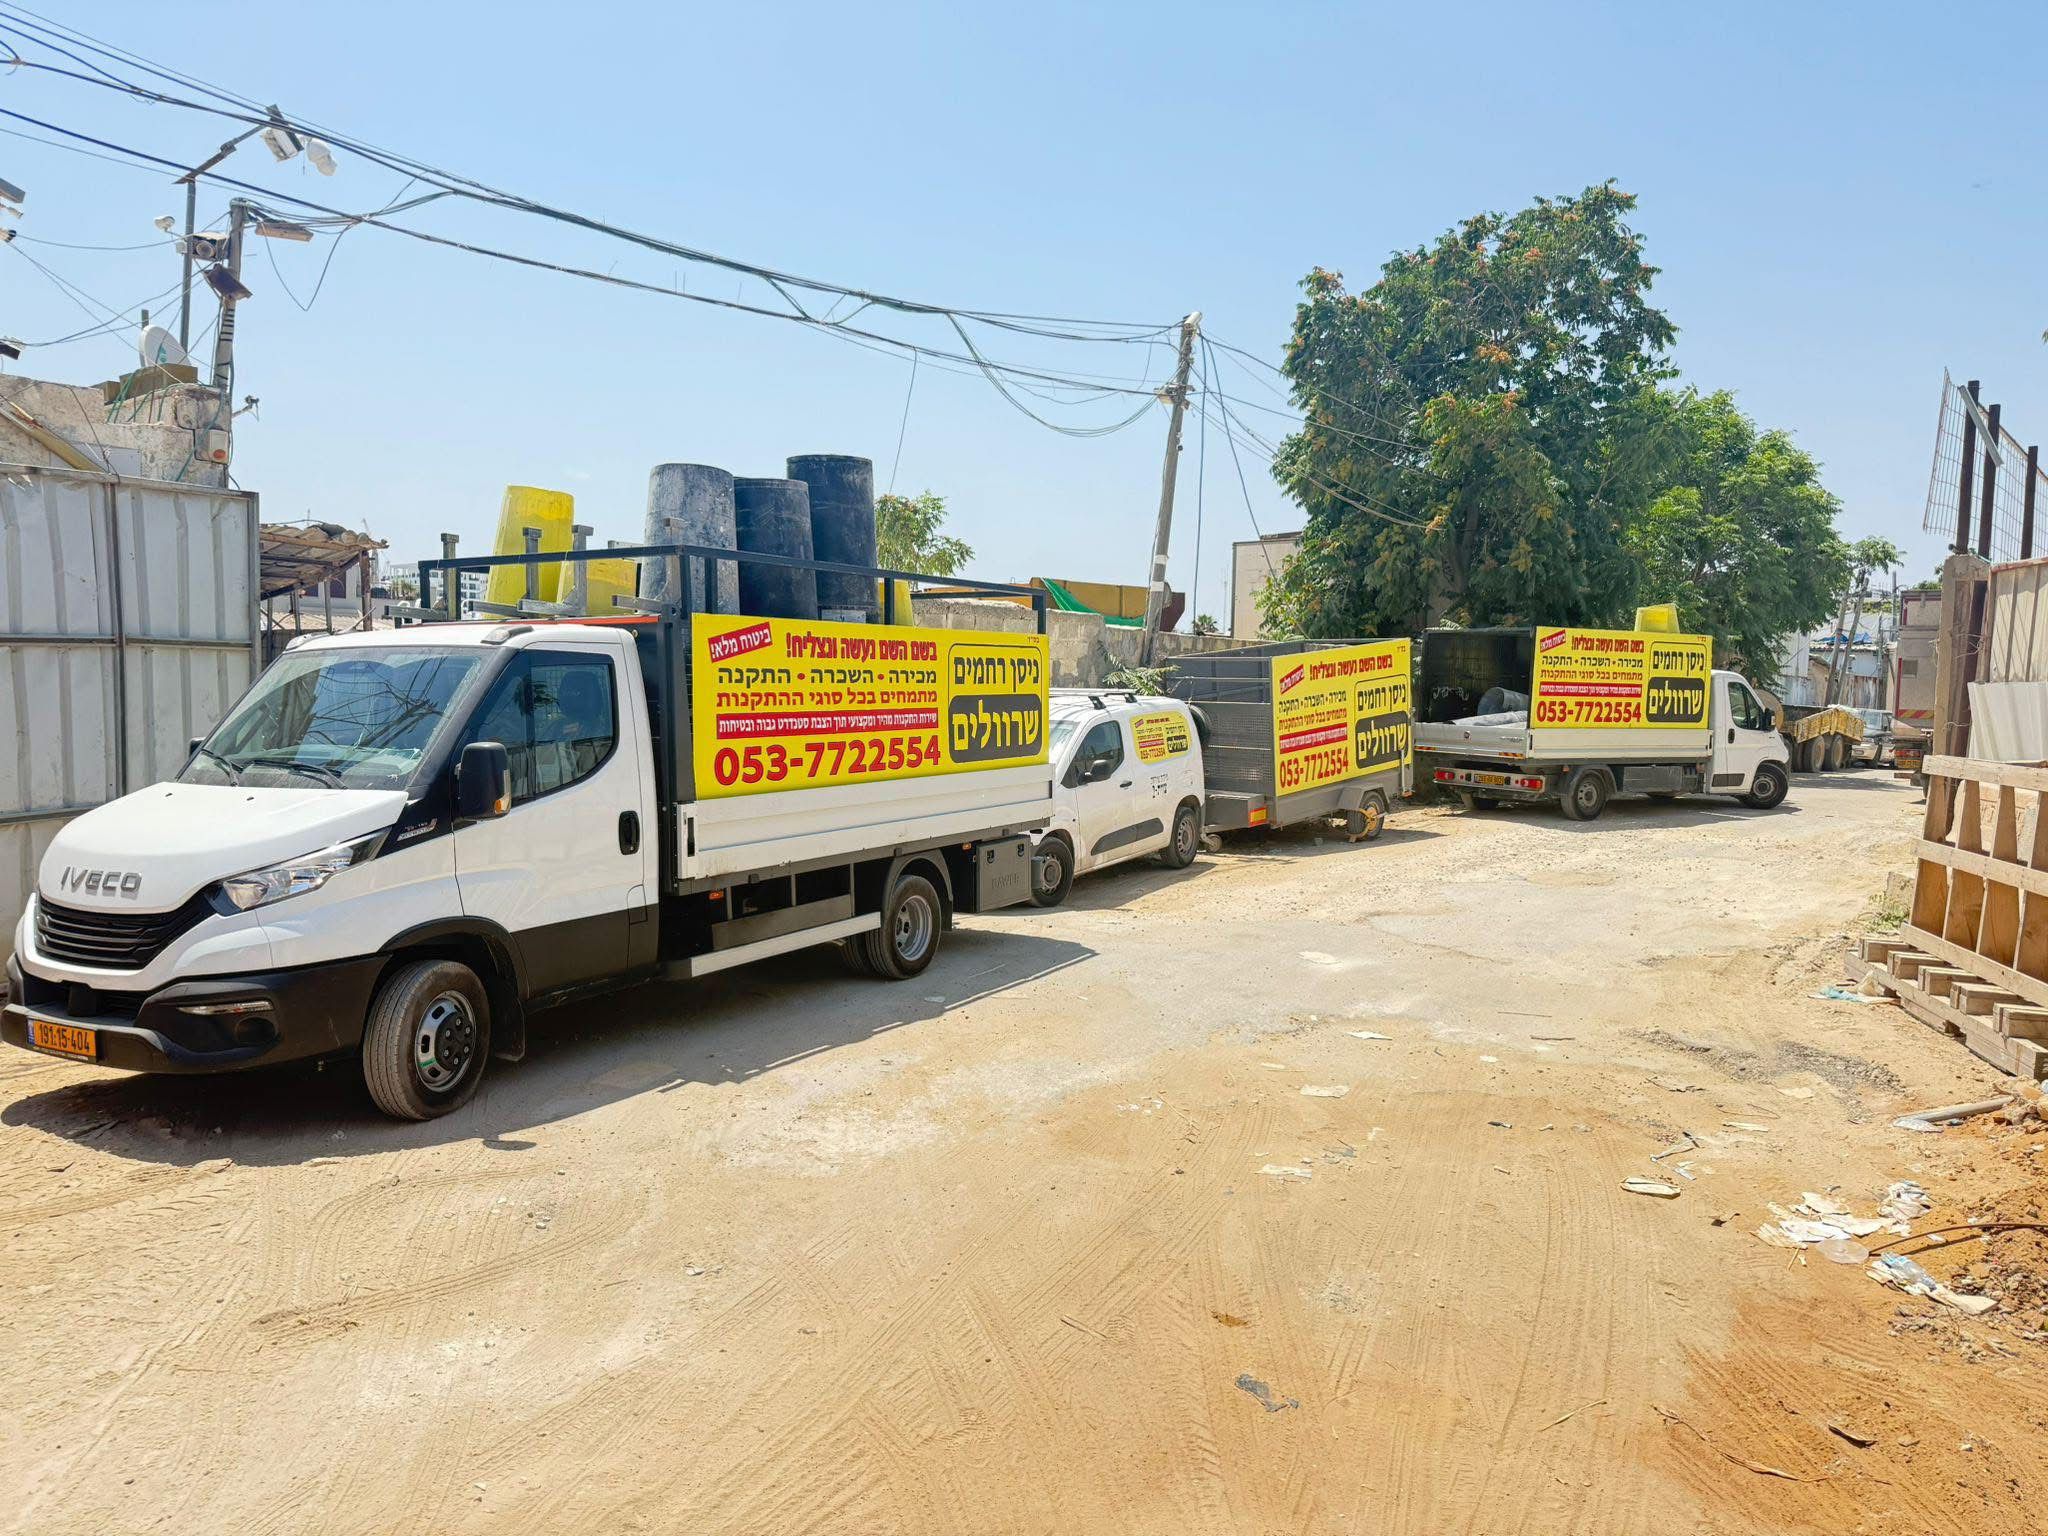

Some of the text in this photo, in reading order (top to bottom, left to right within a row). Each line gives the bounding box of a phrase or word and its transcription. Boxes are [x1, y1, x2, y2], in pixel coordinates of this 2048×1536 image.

[710, 628, 771, 659] ביטוח מלא!
[786, 631, 938, 662] בשם השם נעשה ונצליח!
[953, 657, 1039, 693] ניסן רחמים
[1542, 655, 1572, 668] התקנה
[1617, 658, 1643, 668] מכירה
[1653, 651, 1705, 677] ניסן רחמים
[718, 667, 937, 689] מכירה השכרה התקנה
[716, 687, 938, 711] מתמחים בכל סוגי ההתקנות
[1357, 683, 1406, 712] ניסן רחמים
[1536, 700, 1642, 723] 053-7722554
[1649, 680, 1703, 715] שרוולים
[952, 699, 1039, 751] שרוולים
[1357, 719, 1407, 761] שרוולים
[714, 735, 941, 786] 053-7722554
[1280, 746, 1349, 789] 053-7722554
[61, 866, 142, 893] IVECO
